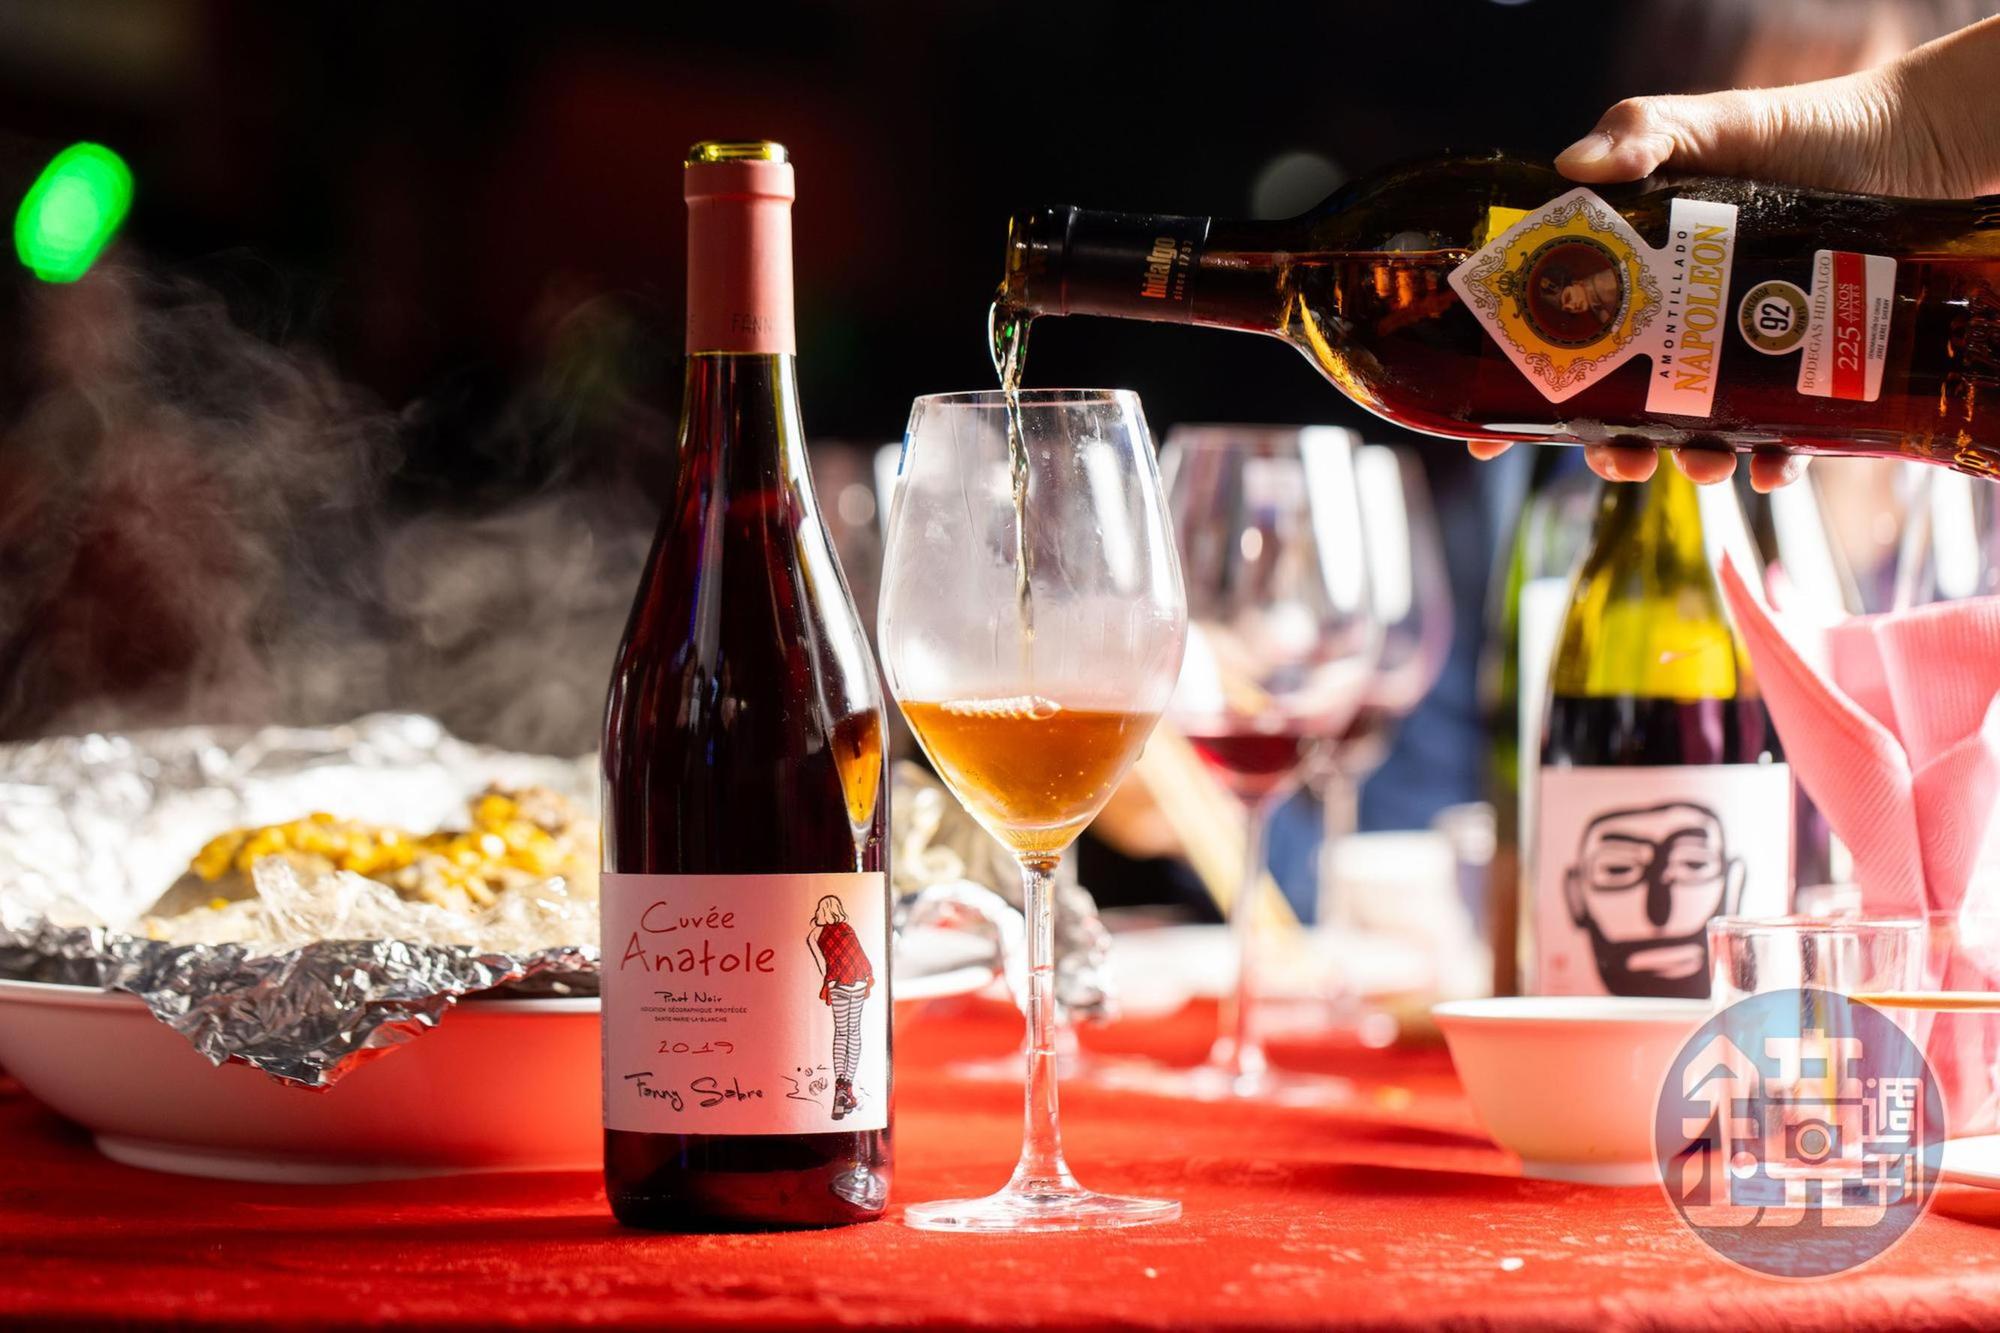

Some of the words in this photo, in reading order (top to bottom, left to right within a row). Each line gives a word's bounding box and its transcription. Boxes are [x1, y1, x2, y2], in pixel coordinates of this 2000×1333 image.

[1141, 238, 1177, 298] hidalgo
[1660, 230, 1687, 378] AMONTILLADO
[1674, 223, 1728, 393] NAPOLEON
[1760, 303, 1790, 331] 92
[1838, 283, 1851, 320] AÑOS
[1851, 285, 1860, 322] YEARS
[1803, 324, 1824, 389] BODEGAS
[1814, 256, 1831, 320] HIDALGO
[1838, 327, 1861, 371] 225
[641, 901, 735, 933] Cuvée
[620, 931, 775, 976] Anatole
[654, 992, 688, 1002] Pinot
[694, 992, 722, 1002] Noir
[658, 1040, 734, 1054] 2019
[624, 1072, 683, 1111] Fanny
[690, 1076, 763, 1107] Sabre
